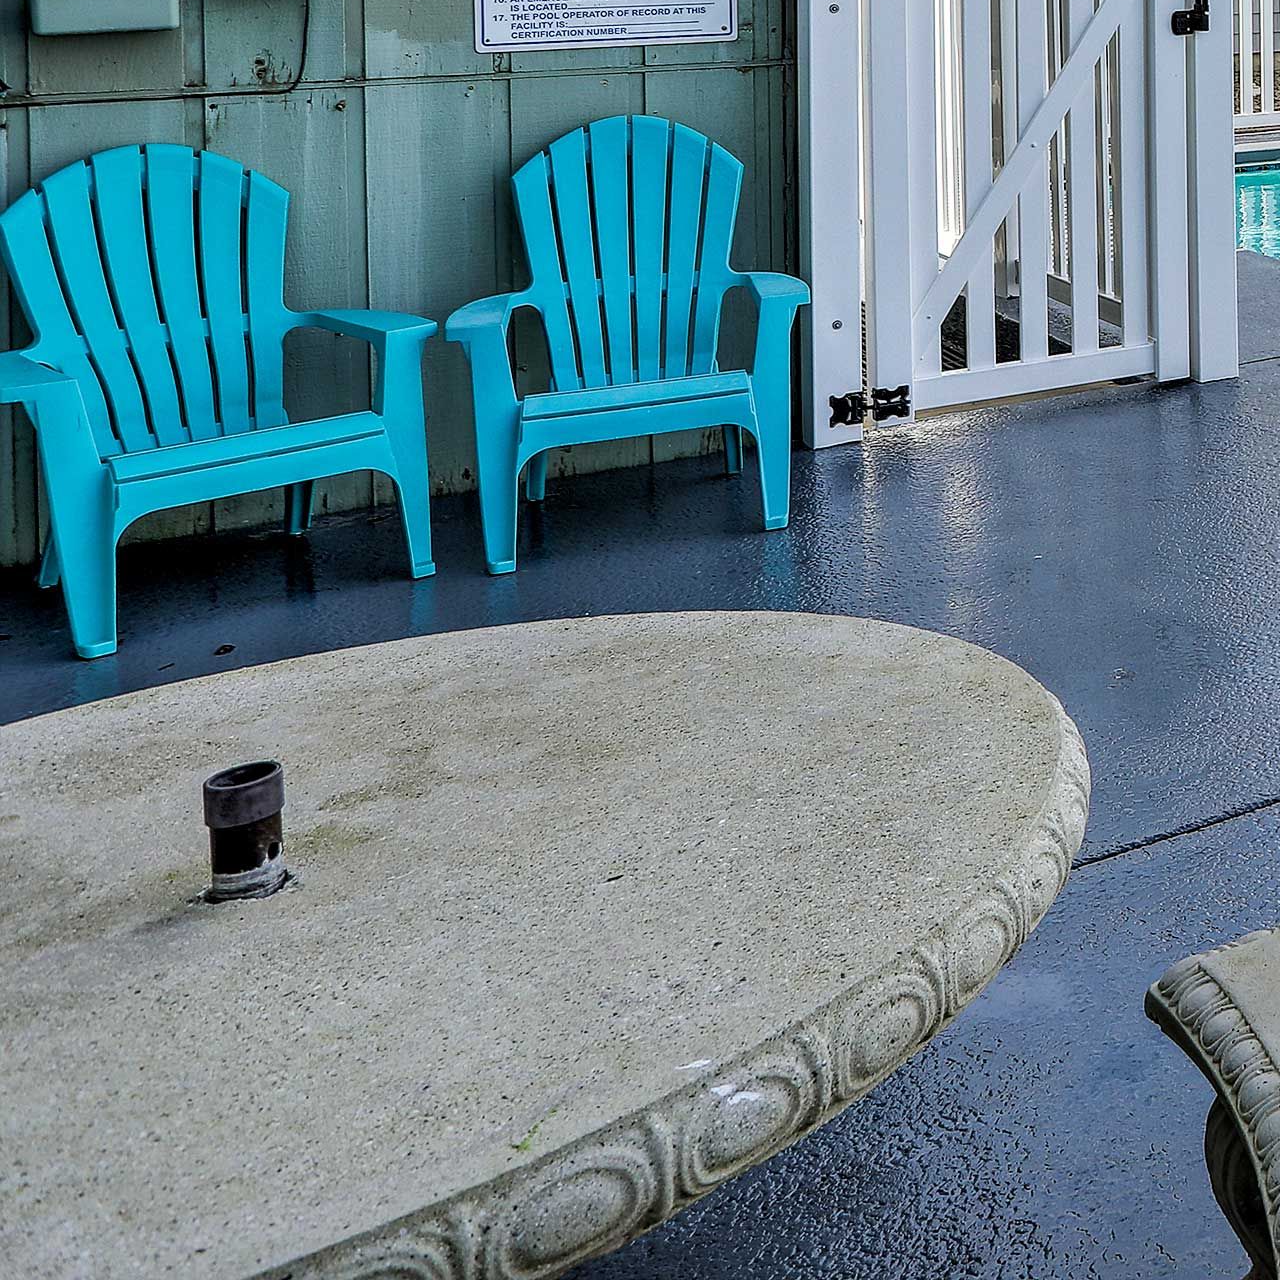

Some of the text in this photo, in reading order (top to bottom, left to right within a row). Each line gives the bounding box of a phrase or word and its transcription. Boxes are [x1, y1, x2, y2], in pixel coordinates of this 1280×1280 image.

[510, 2, 568, 12] IS LOCATED
[510, 12, 529, 21] THE
[532, 11, 559, 20] POOL
[561, 9, 614, 19] OPERATOR
[616, 9, 629, 17] OF
[631, 7, 670, 16] RECORD
[685, 6, 706, 14] THIS
[510, 20, 569, 30] FACILITY IS:
[510, 26, 626, 39] CERTIFICATION NUMBER
